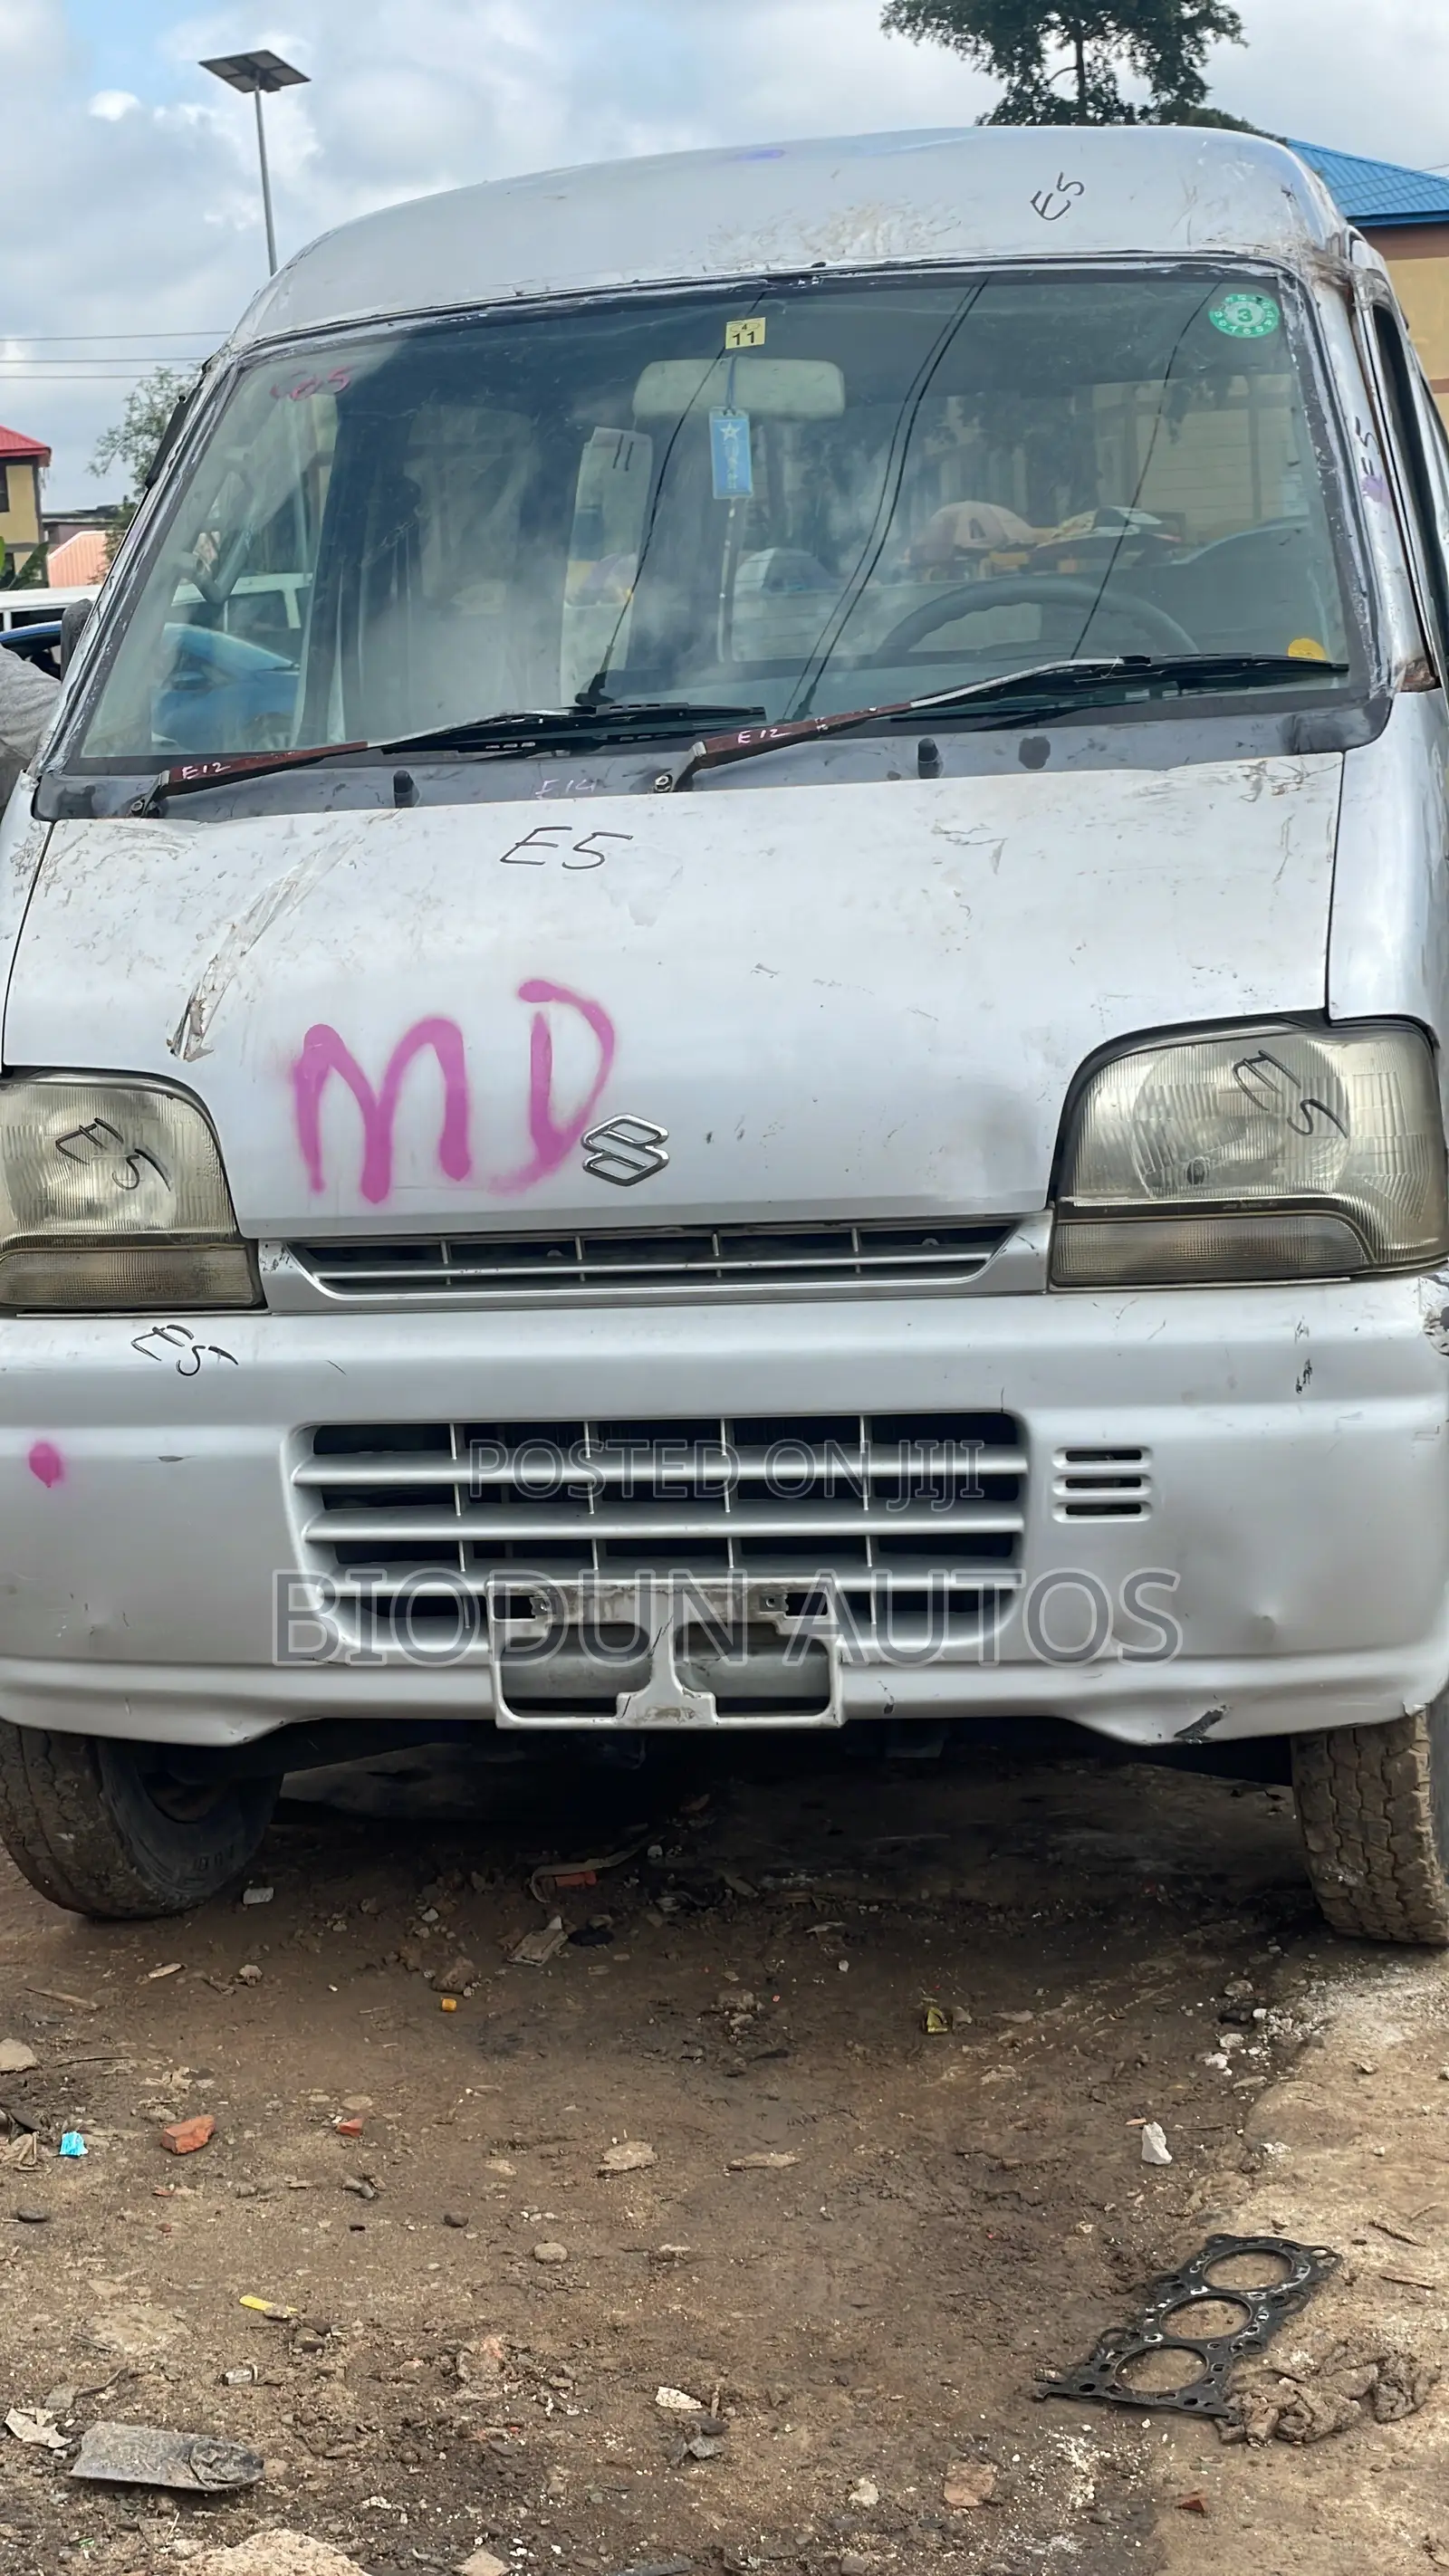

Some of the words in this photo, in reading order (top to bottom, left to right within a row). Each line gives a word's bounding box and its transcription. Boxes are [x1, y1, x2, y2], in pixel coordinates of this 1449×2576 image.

[1030, 171, 1085, 221] E5
[1237, 308, 1252, 321] 3
[732, 330, 755, 346] 11
[737, 728, 793, 744] E12
[181, 761, 232, 780] E12
[500, 826, 634, 870] E5
[1233, 1049, 1348, 1139] E5
[55, 1116, 171, 1192] E5
[130, 1324, 239, 1376] E5
